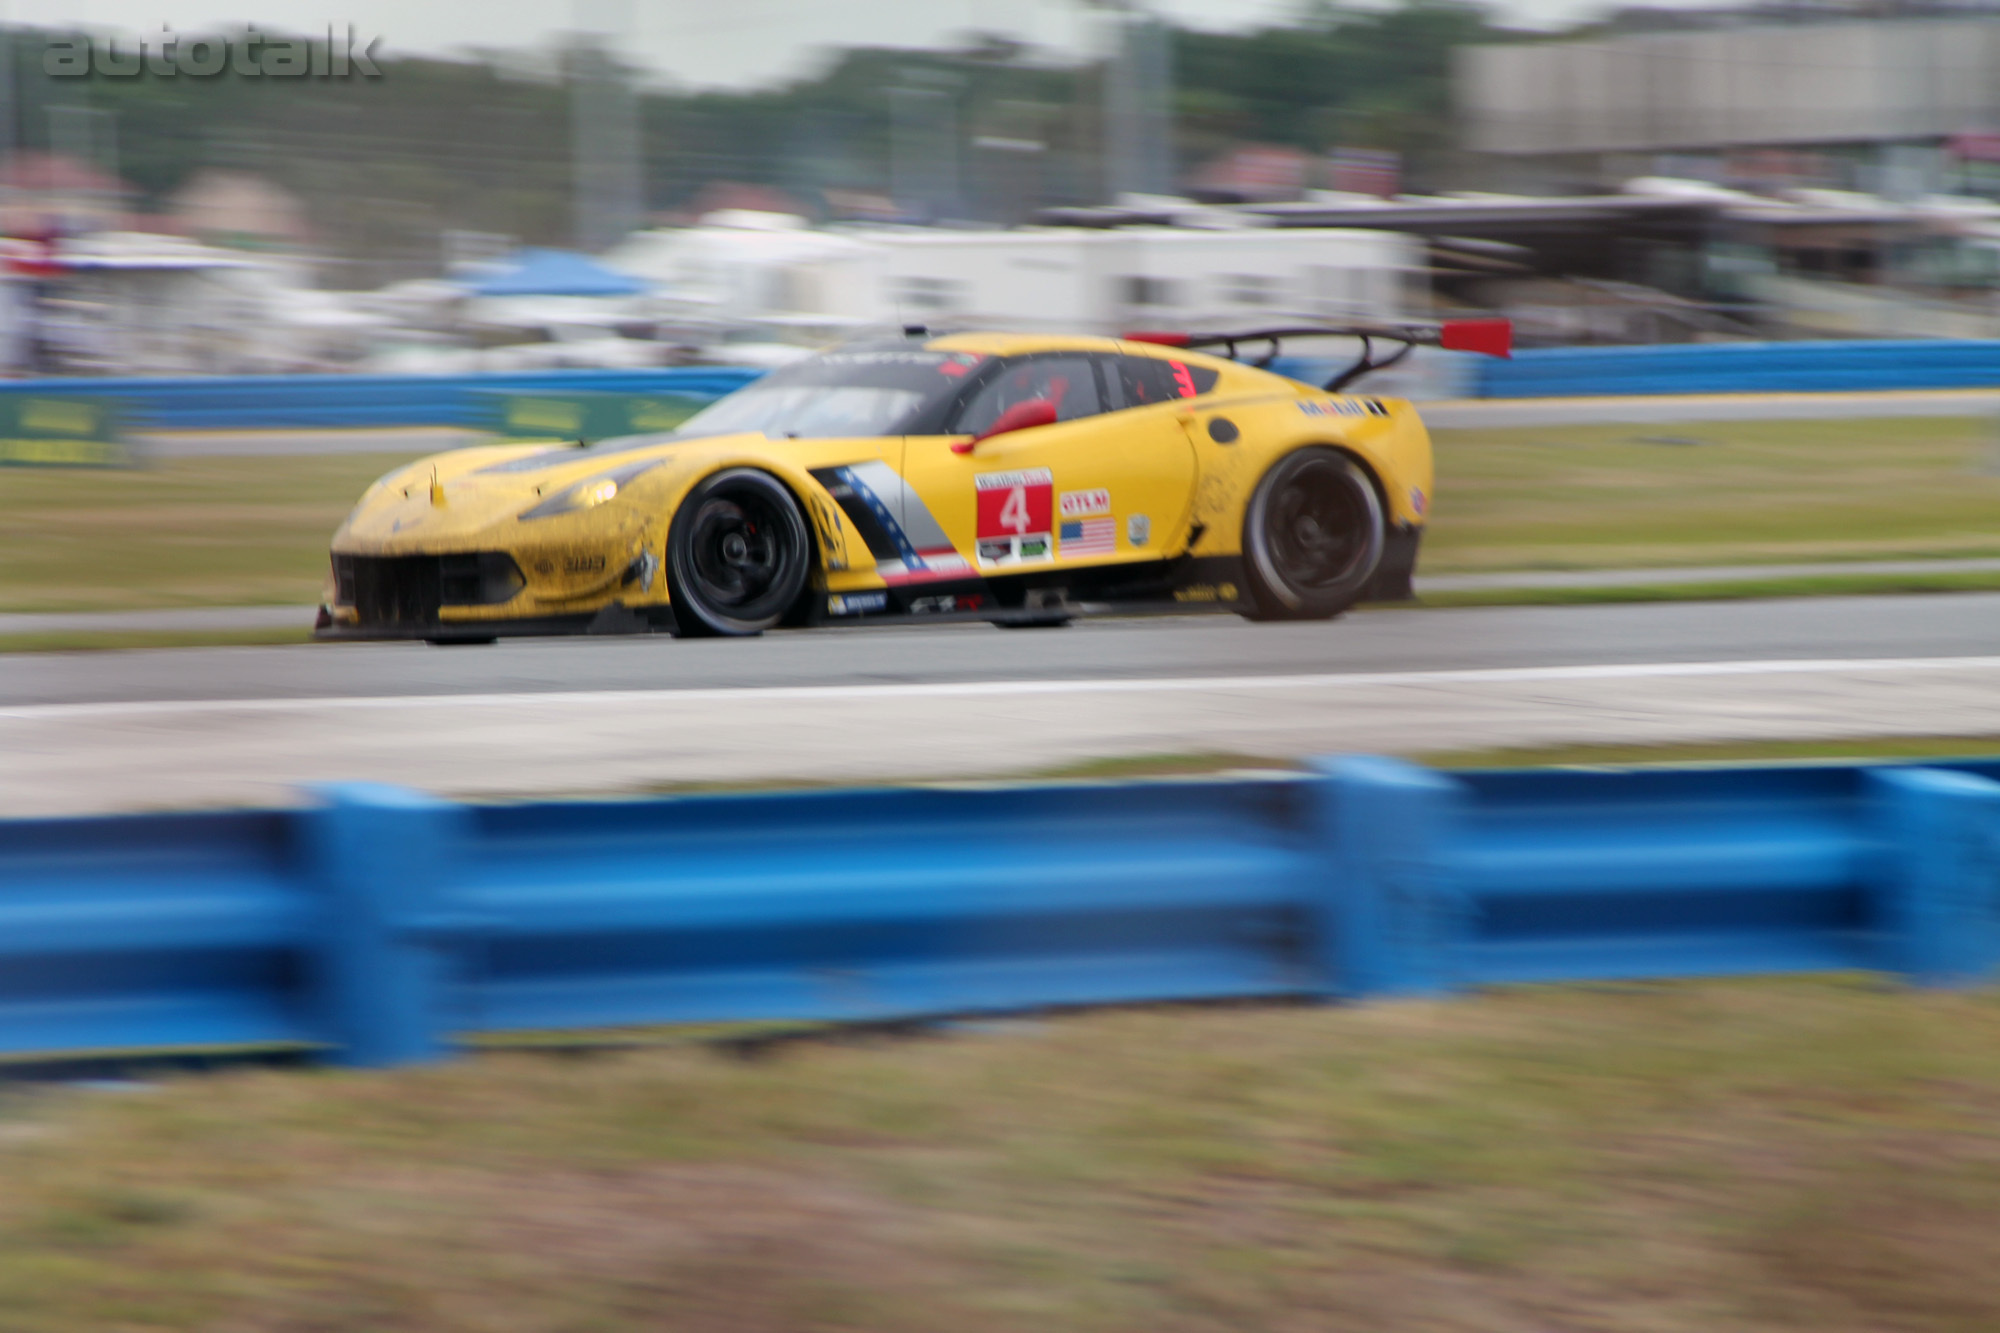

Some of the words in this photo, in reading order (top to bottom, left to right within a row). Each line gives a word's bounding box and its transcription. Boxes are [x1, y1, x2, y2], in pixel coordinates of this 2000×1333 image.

[1296, 399, 1366, 417] Mobil
[1000, 486, 1031, 533] 4
[1063, 492, 1108, 513] GTLM
